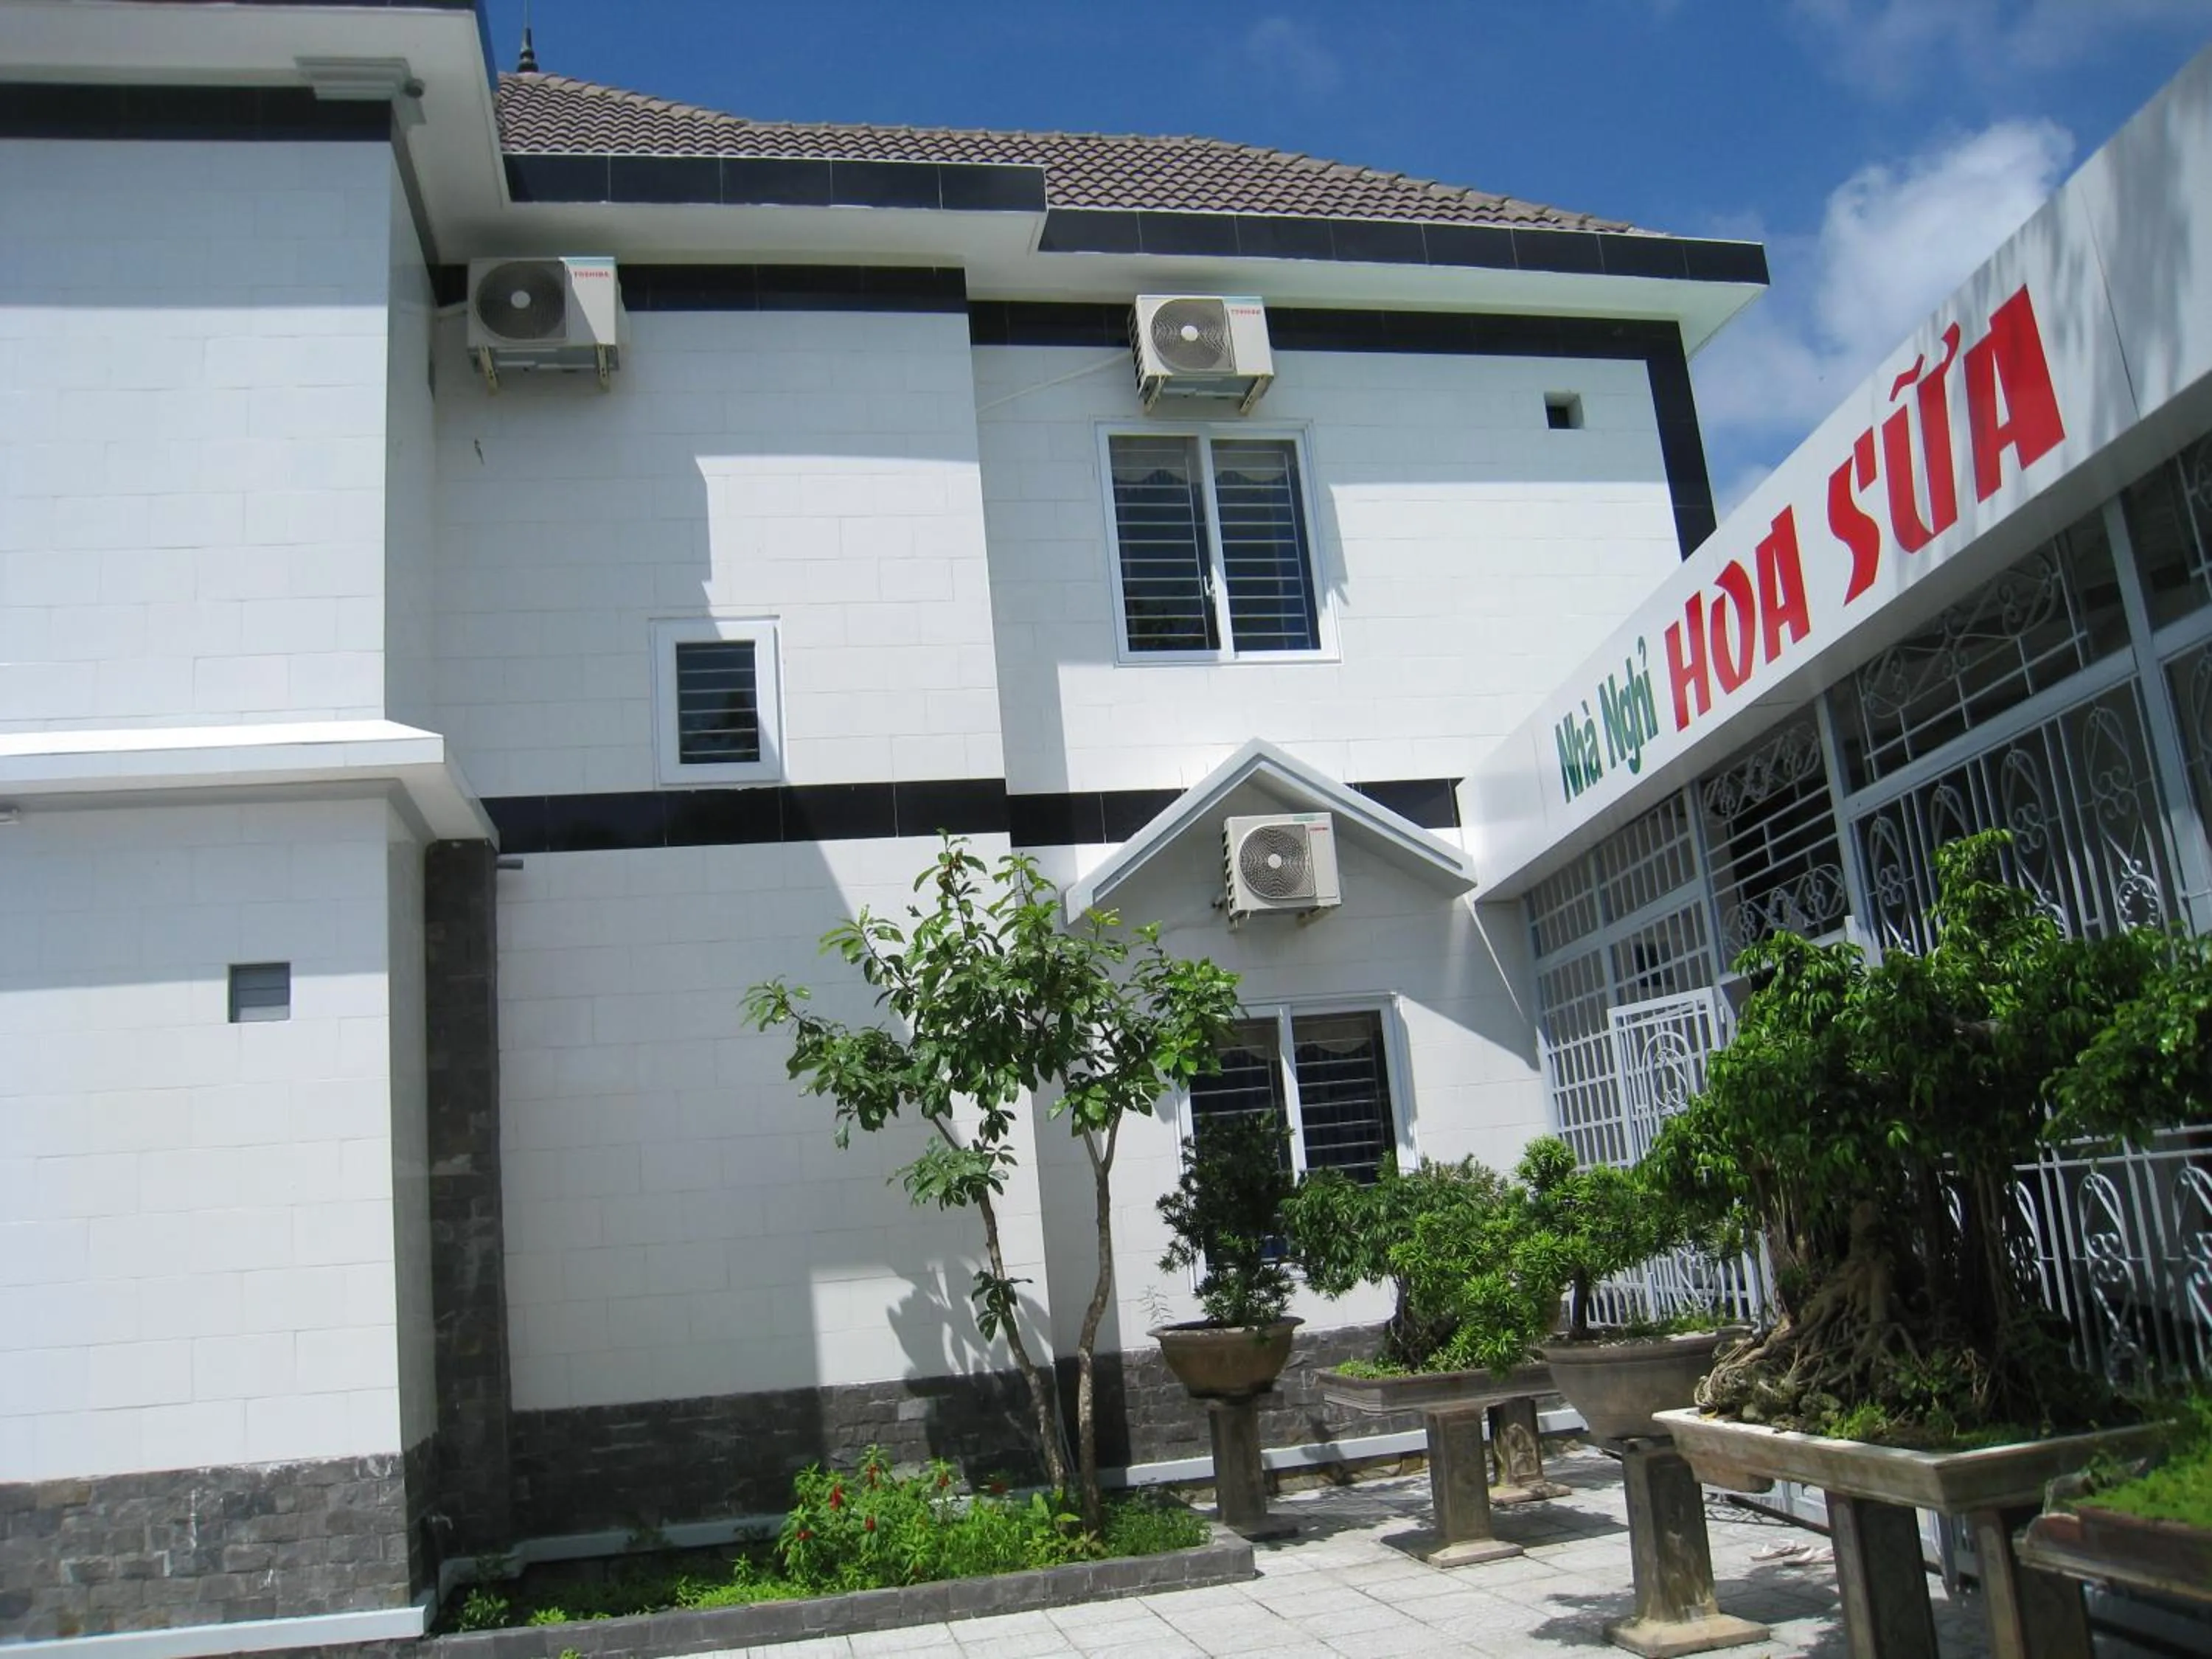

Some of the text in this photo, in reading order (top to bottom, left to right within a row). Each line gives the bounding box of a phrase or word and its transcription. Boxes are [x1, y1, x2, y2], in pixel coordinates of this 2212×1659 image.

[1555, 283, 2065, 804] Nhà Nghỉ HOA SỮA
